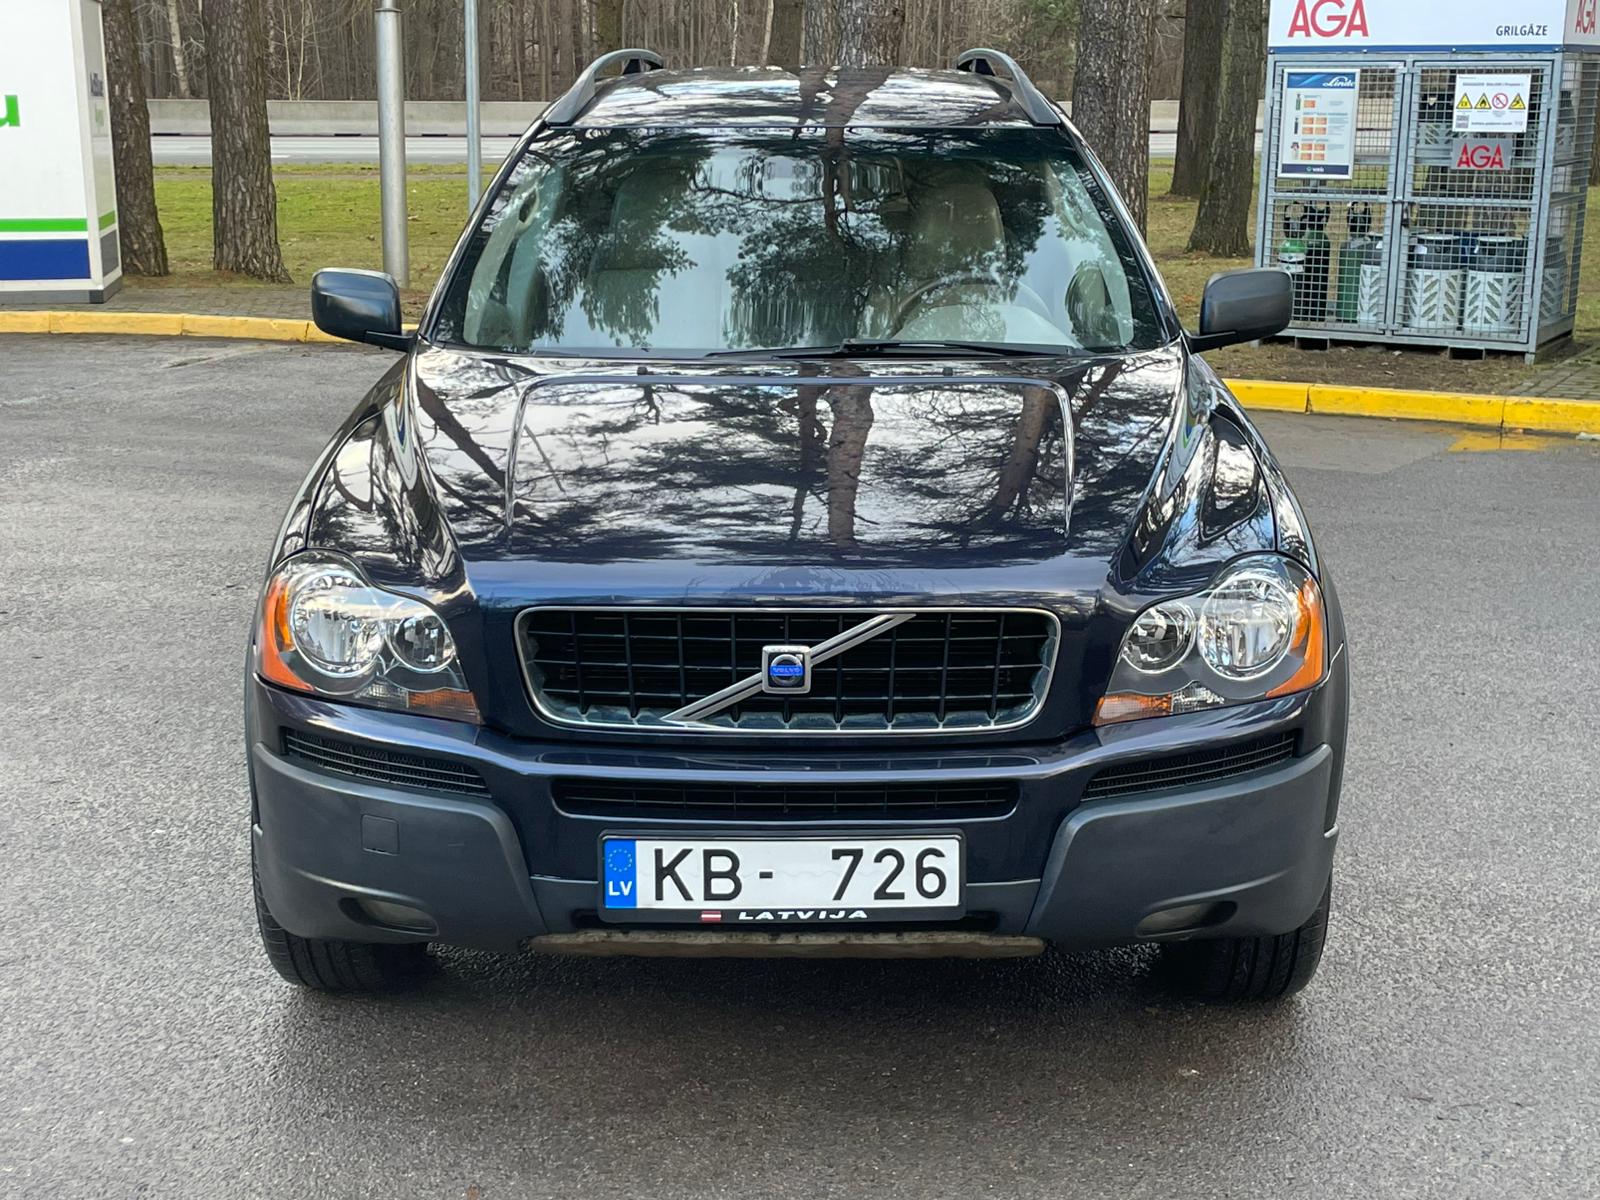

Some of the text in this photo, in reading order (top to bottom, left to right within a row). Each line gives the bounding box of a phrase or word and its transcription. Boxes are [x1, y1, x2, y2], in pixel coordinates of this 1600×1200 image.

[1287, 0, 1369, 38] AGA
[1495, 23, 1548, 37] GRILGĀZE
[1575, 0, 1597, 35] AGA
[1457, 143, 1504, 169] AGA
[831, 847, 947, 901] 726
[608, 880, 632, 896] LV
[738, 910, 868, 921] LATVIJA
